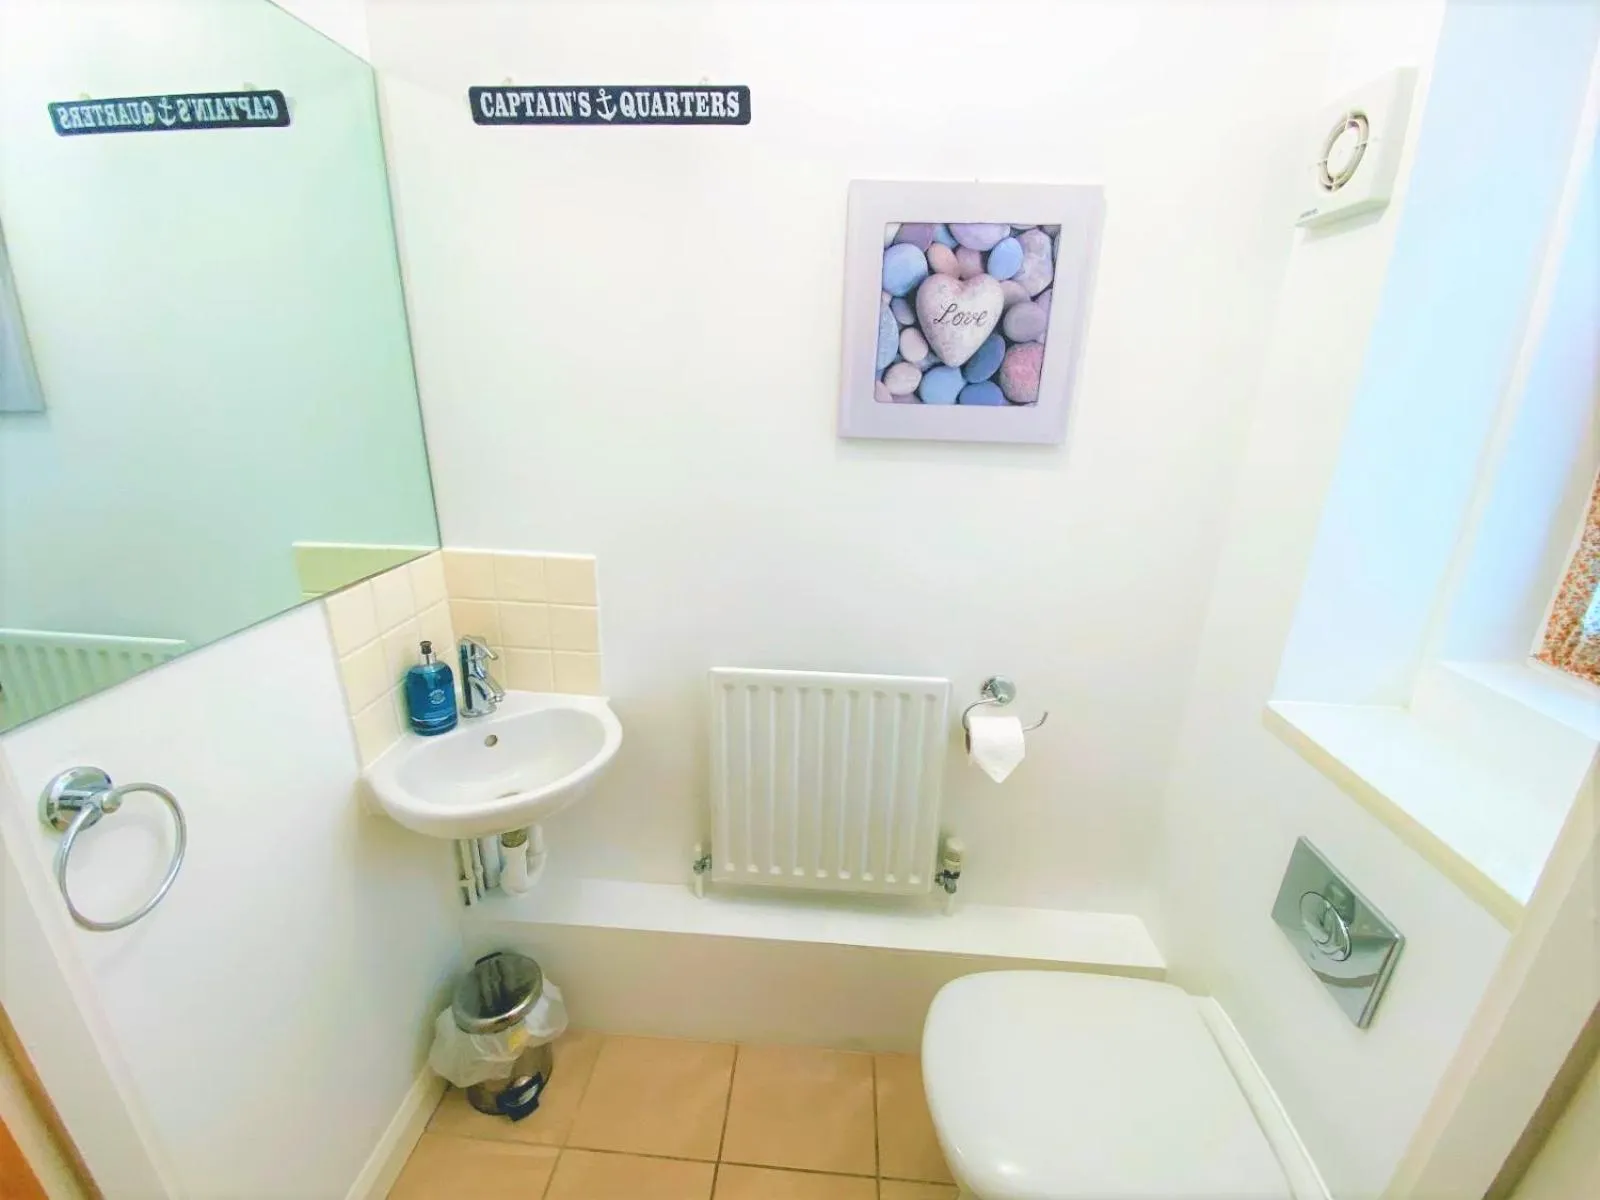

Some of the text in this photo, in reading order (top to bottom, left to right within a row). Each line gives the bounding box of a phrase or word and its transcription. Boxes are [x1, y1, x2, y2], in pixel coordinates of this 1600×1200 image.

[480, 91, 740, 119] CAPTAIN'S QUARTERS
[933, 303, 989, 327] Love
